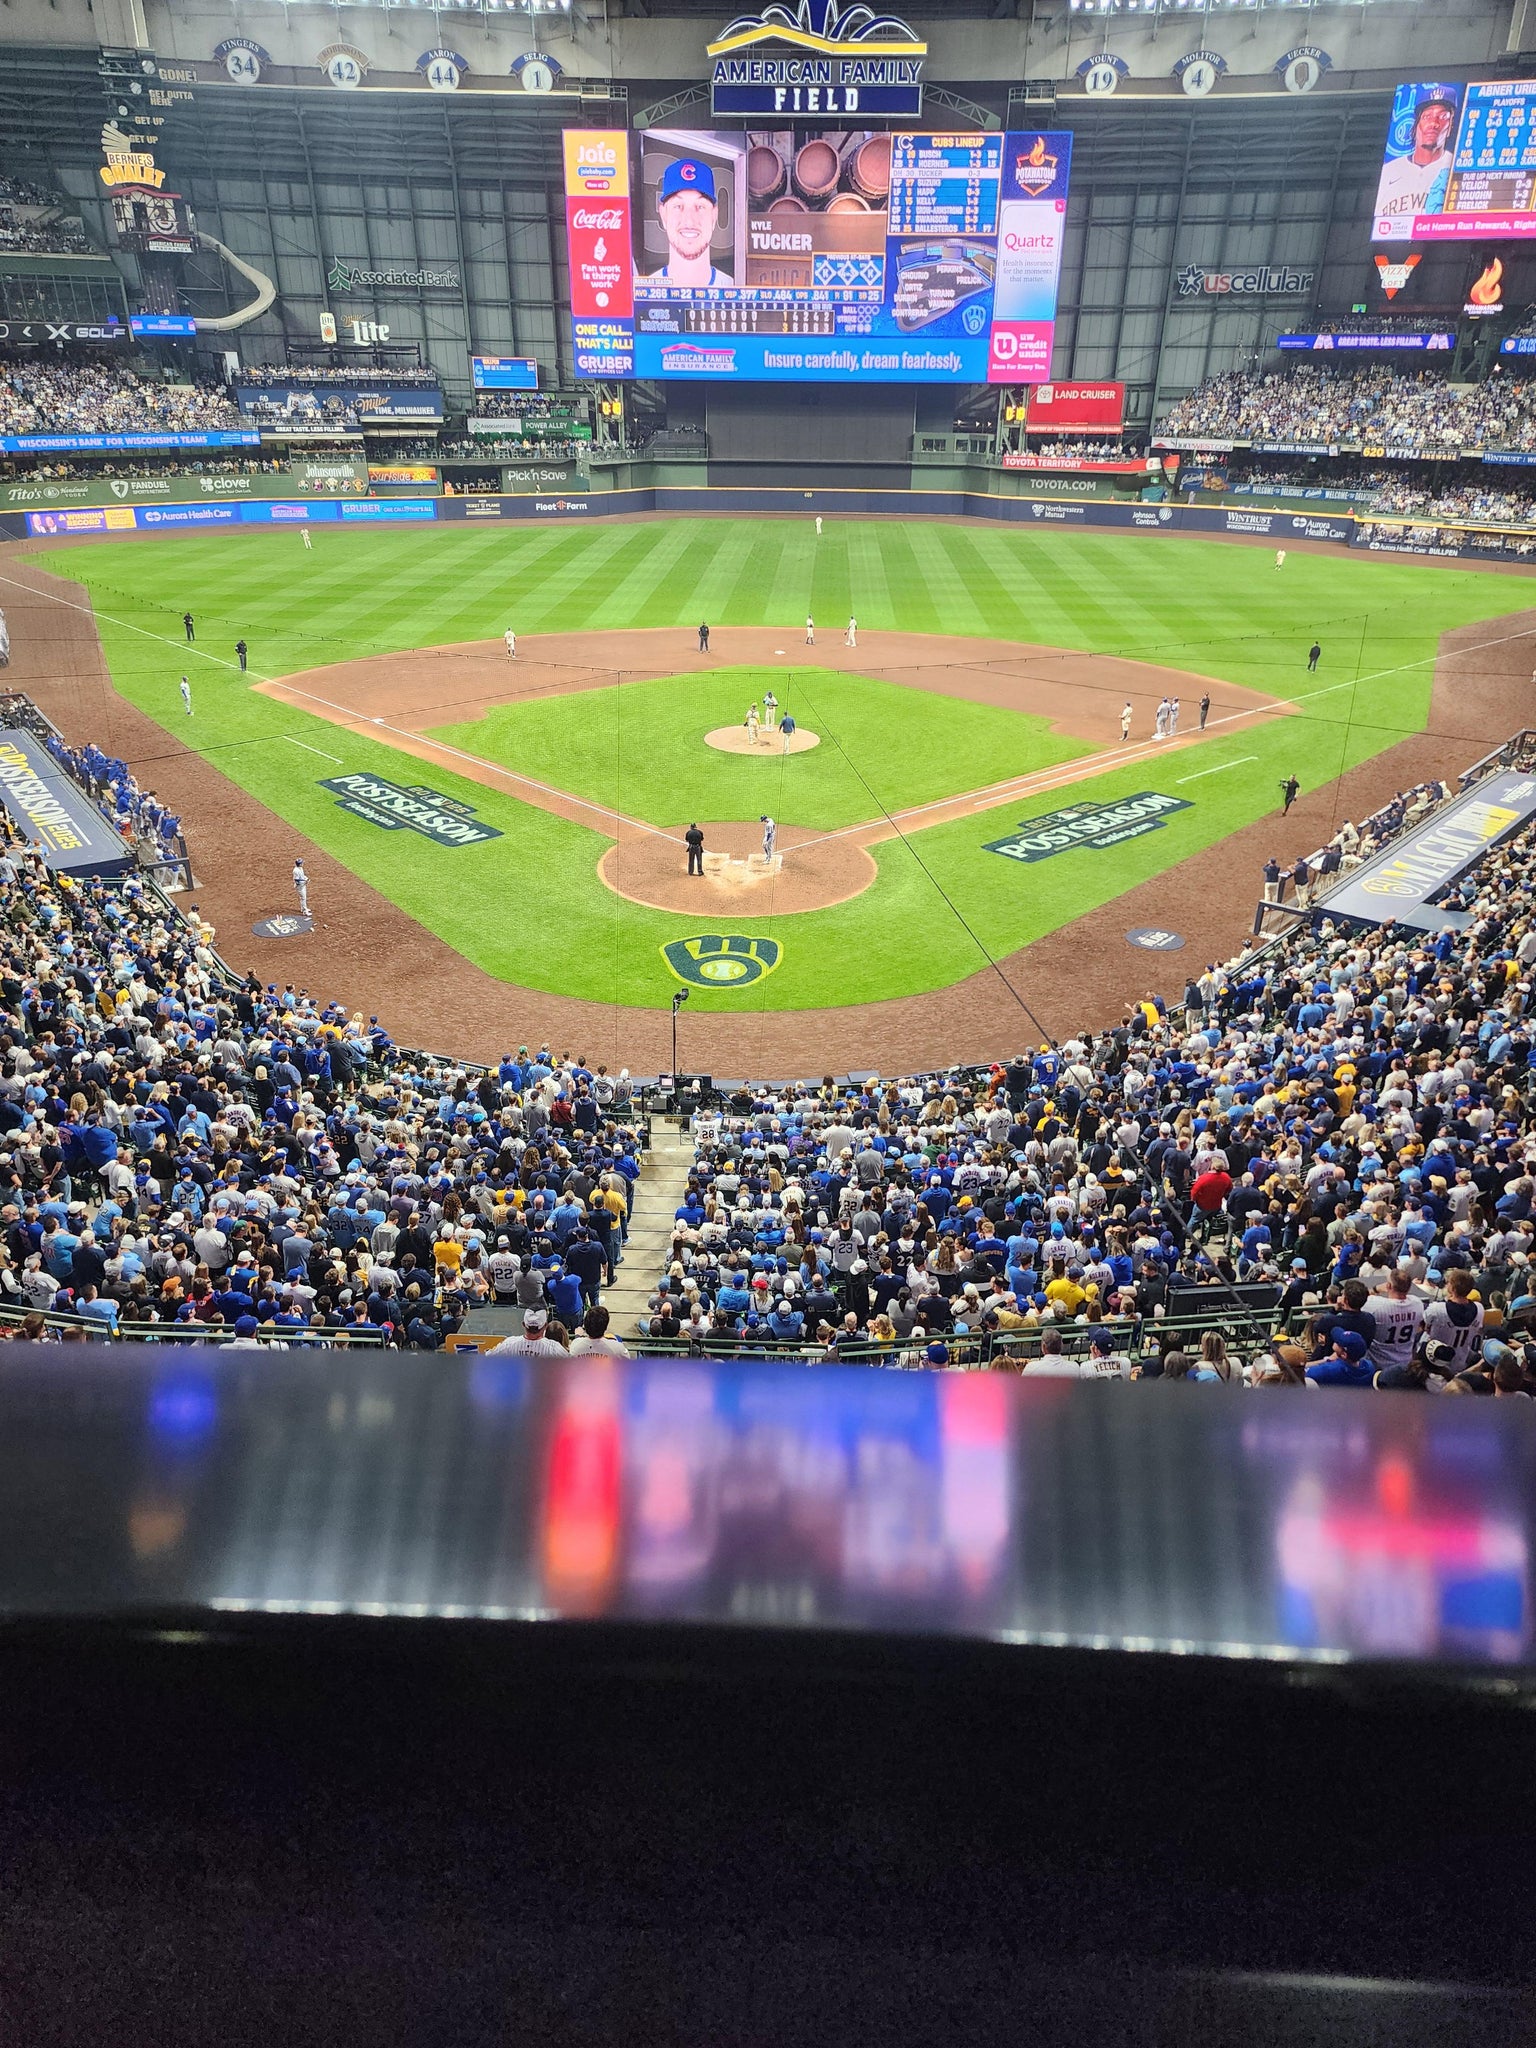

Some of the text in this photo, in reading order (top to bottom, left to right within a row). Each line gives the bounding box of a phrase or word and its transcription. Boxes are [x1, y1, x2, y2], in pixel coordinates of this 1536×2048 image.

[221, 39, 259, 56] FINGERS
[427, 52, 456, 66] AARON
[1088, 55, 1120, 67] YOUNT
[1181, 52, 1222, 67] MOLITOR
[1286, 48, 1322, 62] UECKER
[231, 56, 257, 78] 34
[522, 57, 549, 69] SELIG
[158, 68, 198, 82] GONE!
[333, 65, 357, 86] 42
[431, 67, 456, 89] 44
[713, 60, 923, 84] AMERICAN FAMILY
[532, 70, 543, 89] 1
[1091, 70, 1113, 92] 19
[1191, 68, 1204, 89] 4
[774, 87, 860, 111] FIELD
[1477, 85, 1514, 102] ABNER
[1493, 97, 1526, 107] PLAYOFFS
[134, 116, 165, 126] GET UP
[128, 134, 159, 144] GET UP
[931, 137, 986, 149] CUBS LINEUP
[576, 140, 617, 165] Joie
[108, 153, 154, 167] BERNIE'S
[99, 165, 166, 188] CHALET
[680, 163, 697, 180] C
[572, 208, 625, 230] Coca-Cola
[751, 220, 772, 231] KYLE
[1432, 222, 1456, 231] Home
[751, 233, 813, 251] TUCKER
[1004, 232, 1054, 253] Quartz
[581, 263, 622, 273] Fan work
[1003, 259, 1054, 267] Health insurance
[350, 267, 460, 288] Associated Bank
[589, 272, 621, 283] thirsty
[591, 281, 614, 289] work
[44, 324, 126, 340] X GOLF
[352, 320, 390, 346] Lite
[575, 324, 597, 336] ONE
[575, 338, 610, 351] THAT'S
[1019, 342, 1048, 350] credit
[664, 353, 735, 363] AMERICAN FAMILY
[1019, 350, 1047, 359] union
[577, 355, 633, 369] GRUBER
[764, 350, 963, 374] Insure carefully, dream fearlessly.
[1054, 390, 1116, 400] LAND CRUISER
[354, 396, 392, 414] Miller
[375, 405, 435, 415] TIME, MILWAUKEE
[525, 422, 568, 430] POWER ALLEY
[17, 435, 208, 448] WISCONSIN'S BANK FOR WISCONSIN'S TEAMS
[1362, 447, 1419, 459] 620 WTMJ
[1483, 453, 1520, 463] WINTRUST
[1004, 457, 1082, 468] TOYOTA TERRITORY
[305, 463, 355, 479] Johnsonville
[369, 470, 411, 482] Surfside
[540, 470, 567, 480] Save
[130, 481, 170, 490] FANDUEL
[213, 476, 251, 489] clover
[1030, 479, 1097, 491] TOYOTA.COM
[8, 486, 42, 501] Tito's
[342, 504, 381, 514] GRUBER
[536, 502, 588, 511] Fleet Farm
[1045, 504, 1084, 514] Northwestern
[66, 512, 104, 521] WINNING
[161, 509, 234, 521] Aurora Health Care
[1044, 511, 1066, 519] Mutual
[1131, 511, 1156, 520] Johnson
[1227, 511, 1272, 525] WINTRUST
[66, 518, 101, 527] RECORD
[1135, 518, 1160, 526] Controls
[1306, 519, 1331, 529] Aurora
[1304, 527, 1347, 539] Health Care
[1378, 542, 1458, 557] Aurora Health Care BULLPEN
[330, 774, 489, 843] POSTSEASON
[994, 794, 1182, 860] POSTSEASON
[47, 824, 84, 850] 2025
[701, 1129, 715, 1140] 28
[962, 1179, 978, 1189] 23
[179, 1193, 196, 1205] 22
[843, 1201, 858, 1211] 22
[838, 1243, 853, 1254] 23
[494, 1268, 514, 1280] 22
[1389, 1311, 1418, 1324] YOUNT
[1384, 1323, 1414, 1345] 19
[1453, 1329, 1470, 1349] 11
[1093, 1360, 1121, 1373] YELICH
